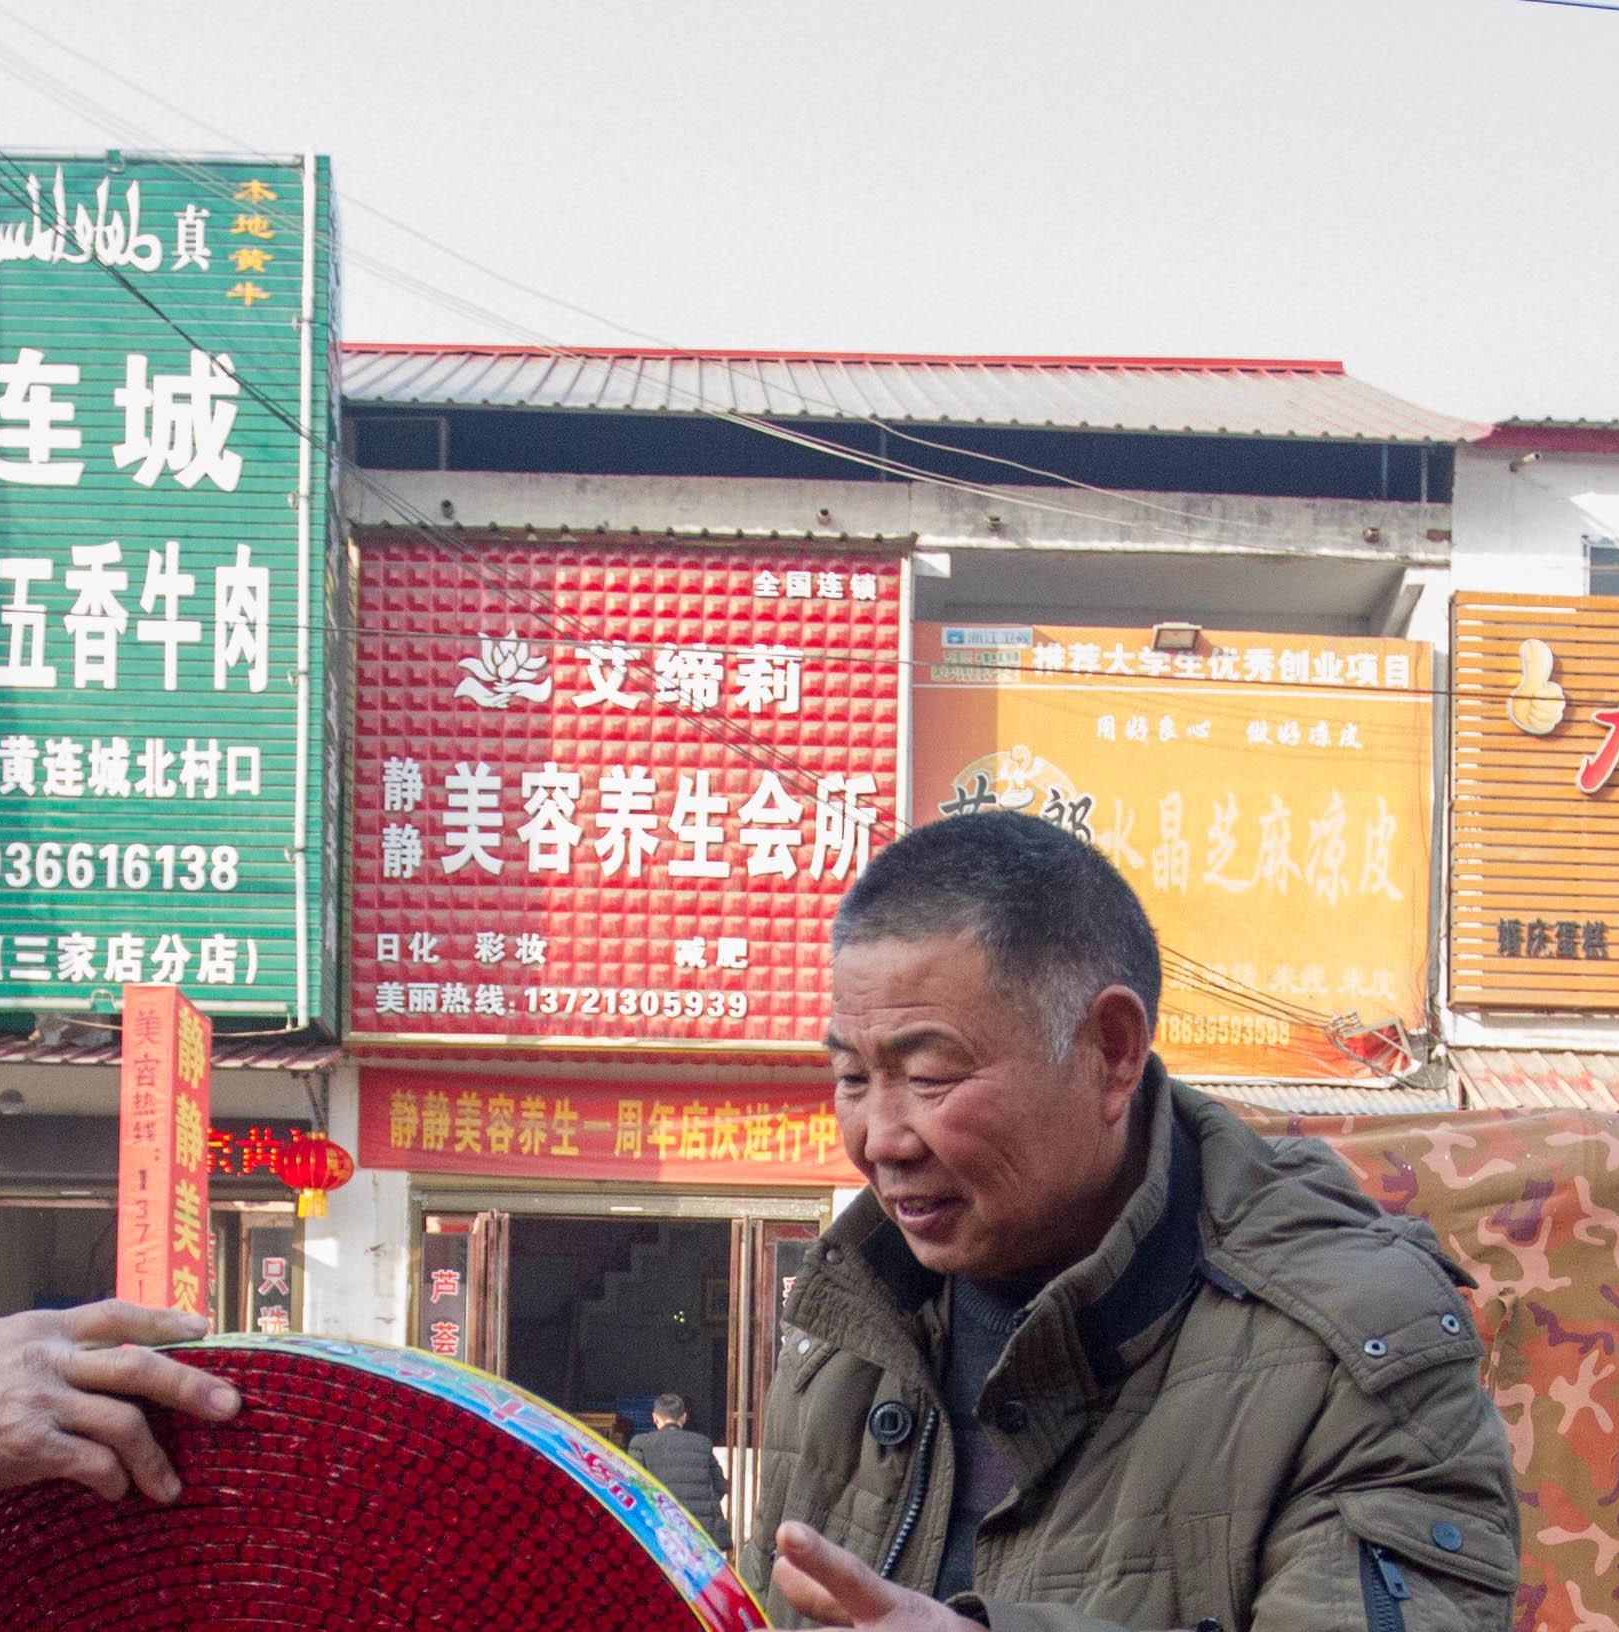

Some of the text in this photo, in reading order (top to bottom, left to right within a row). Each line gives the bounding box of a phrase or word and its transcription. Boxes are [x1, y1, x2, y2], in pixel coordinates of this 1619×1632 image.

[226, 180, 278, 306] 本地黄牛
[753, 571, 877, 601] 全国连锁
[571, 639, 805, 714] 艾缔莉
[1031, 641, 1410, 689] 推荐大学生优秀创业项目
[1096, 715, 1364, 751] 用好良心 做好凉皮
[381, 756, 424, 880] 静静
[441, 761, 878, 881] 美容养生会所
[1098, 791, 1403, 906] 水晶芝麻凉皮
[375, 931, 748, 970] 日化 彩妆 减肥
[389, 1087, 837, 1164] 静静美容养生一周年店庆进行中
[431, 1269, 461, 1357] 芦荟
